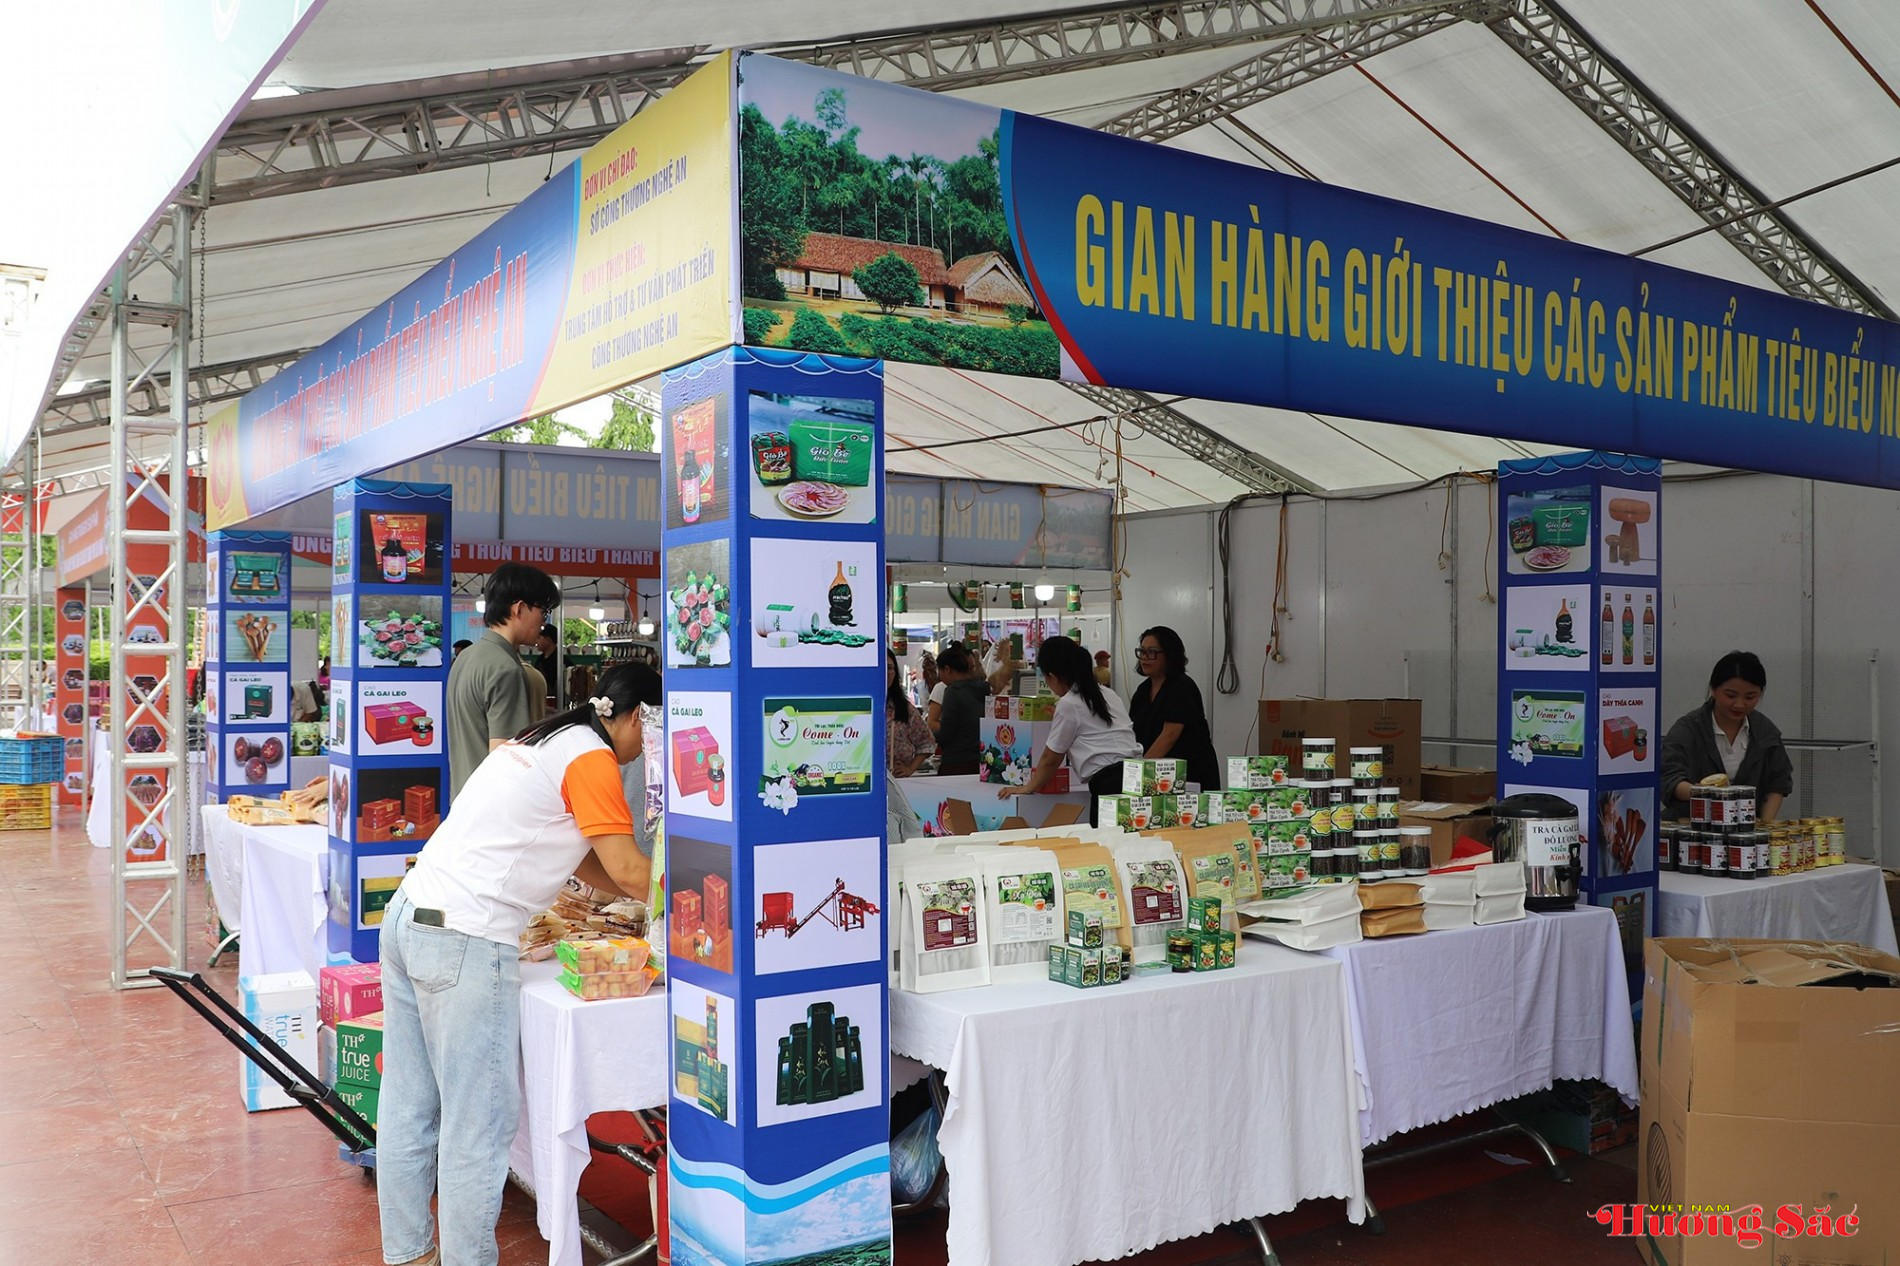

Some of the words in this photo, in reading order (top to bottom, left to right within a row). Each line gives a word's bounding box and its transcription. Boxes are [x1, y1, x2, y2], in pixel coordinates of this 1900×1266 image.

[584, 176, 600, 202] ĐƠN
[599, 172, 606, 196] VỊ
[606, 149, 621, 188] CHỈ
[620, 146, 638, 178] ĐẠO:
[590, 208, 600, 236] SỞ
[600, 198, 620, 230] CÔNG
[621, 179, 652, 220] THƯƠNG
[651, 163, 674, 200] NGHỆ
[674, 155, 687, 182] AN
[565, 312, 587, 343] TRUNG
[587, 304, 602, 335] TÂM
[613, 288, 628, 322] TRỢ
[629, 292, 635, 311] &
[665, 262, 687, 296] PHÁT
[688, 241, 714, 285] TRIỂN
[1075, 194, 1195, 321] GIAN
[1211, 204, 1331, 342] HÀNG
[1344, 236, 1422, 358] GIỚI
[1433, 260, 1533, 393] THIỆU
[1544, 277, 1605, 389] CÁC
[1615, 281, 1674, 400] SẢN
[1682, 296, 1759, 414] PHẨM
[1766, 327, 1819, 425] TIÊU
[1823, 326, 1876, 434] BIỂU
[398, 300, 428, 412] TIÊU
[424, 257, 461, 407] BIỂU
[457, 246, 502, 403] NGHỆ
[500, 250, 528, 373] AN
[591, 335, 610, 370] CÔNG
[612, 324, 642, 363] THƯƠNG
[643, 311, 665, 349] NGHỆ
[665, 311, 678, 339] AN
[680, 707, 691, 717] GAI
[691, 708, 703, 717] LEO
[1536, 708, 1558, 720] Come
[1563, 711, 1576, 721] On
[802, 727, 834, 740] Come
[843, 726, 860, 739] On
[1533, 824, 1550, 834] TRÀ
[1551, 823, 1562, 833] CÀ
[361, 989, 376, 999] TH
[275, 1014, 290, 1047] true
[342, 1034, 358, 1048] TH
[341, 1047, 370, 1068] true
[341, 1065, 370, 1082] JUICE
